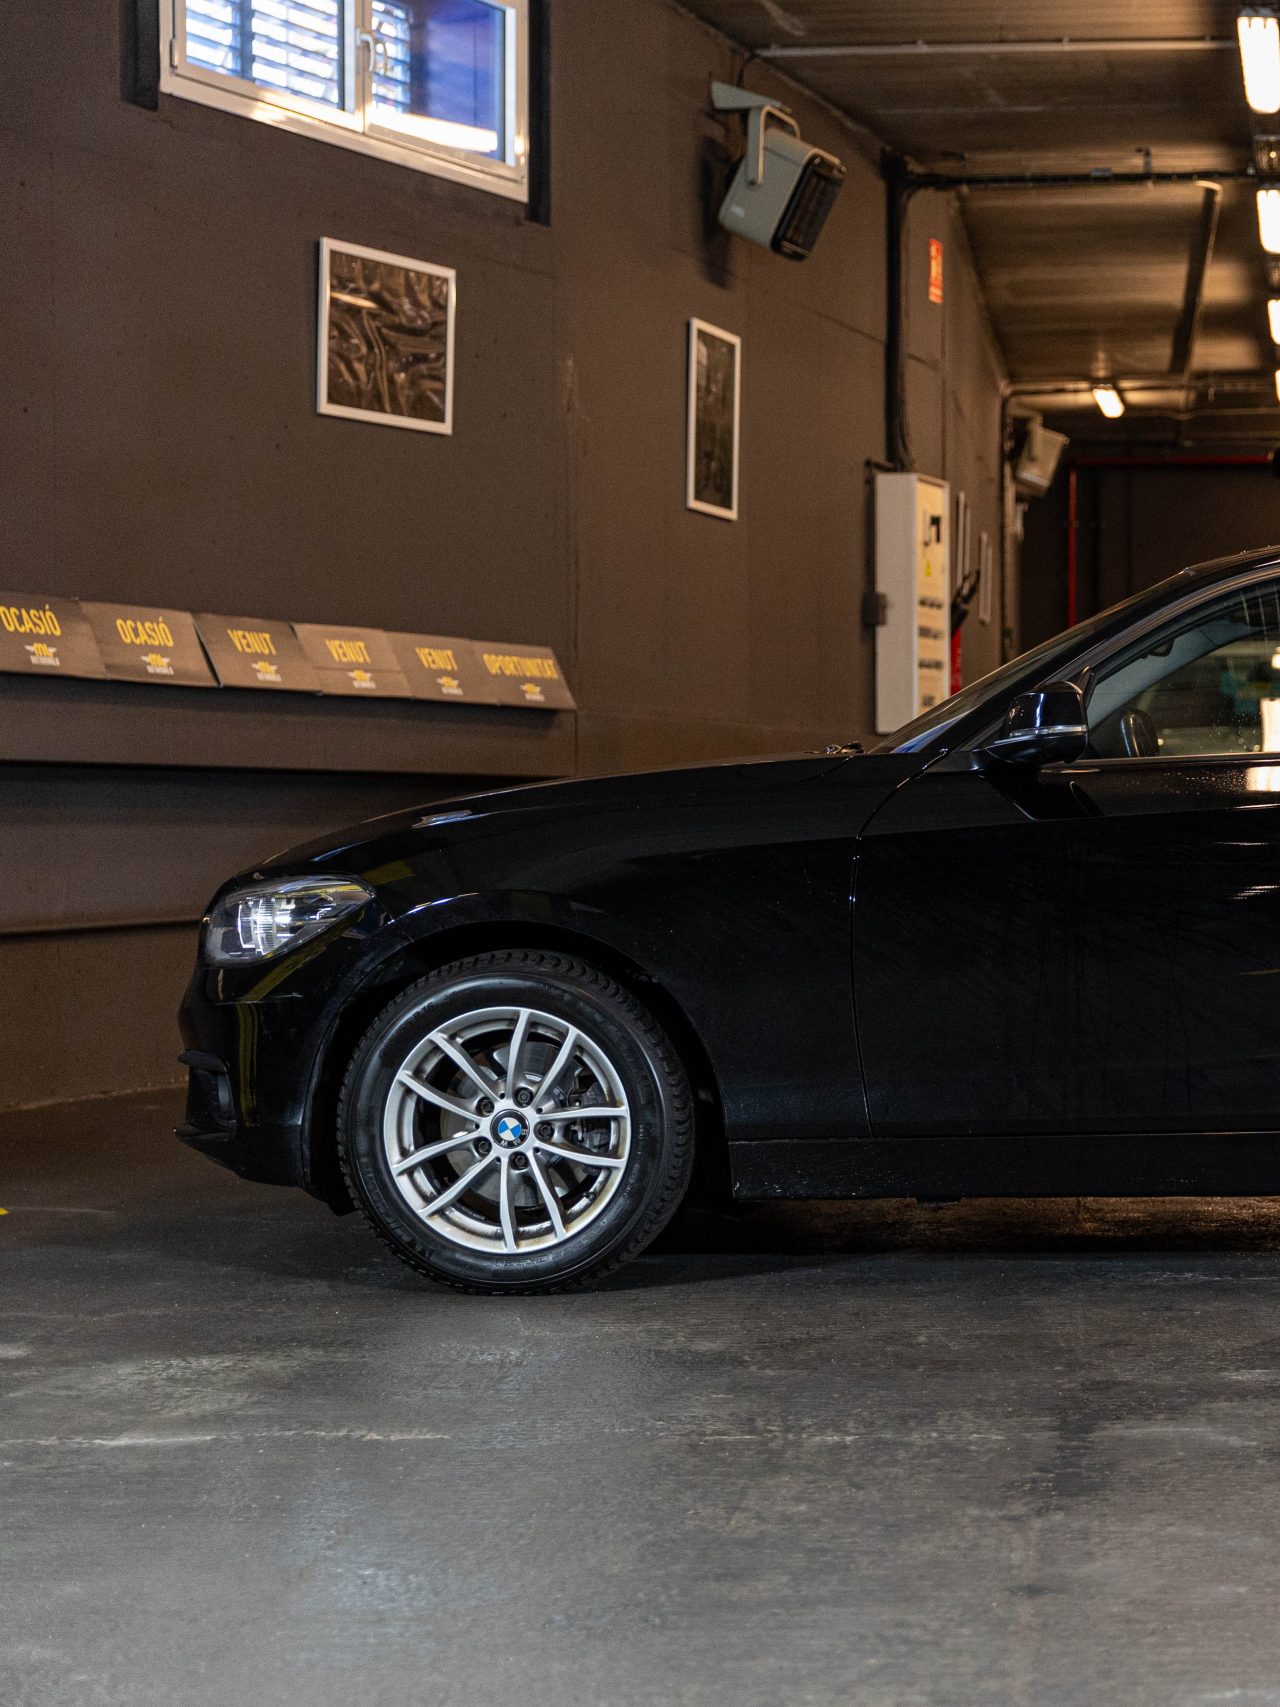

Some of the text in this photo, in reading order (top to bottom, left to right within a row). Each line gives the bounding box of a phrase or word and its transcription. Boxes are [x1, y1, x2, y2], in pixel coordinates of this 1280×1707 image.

[0, 604, 62, 636] OCASIÓ
[115, 616, 174, 648] OCASIÓ
[227, 628, 277, 656] VENUT
[324, 638, 372, 664] VENUT
